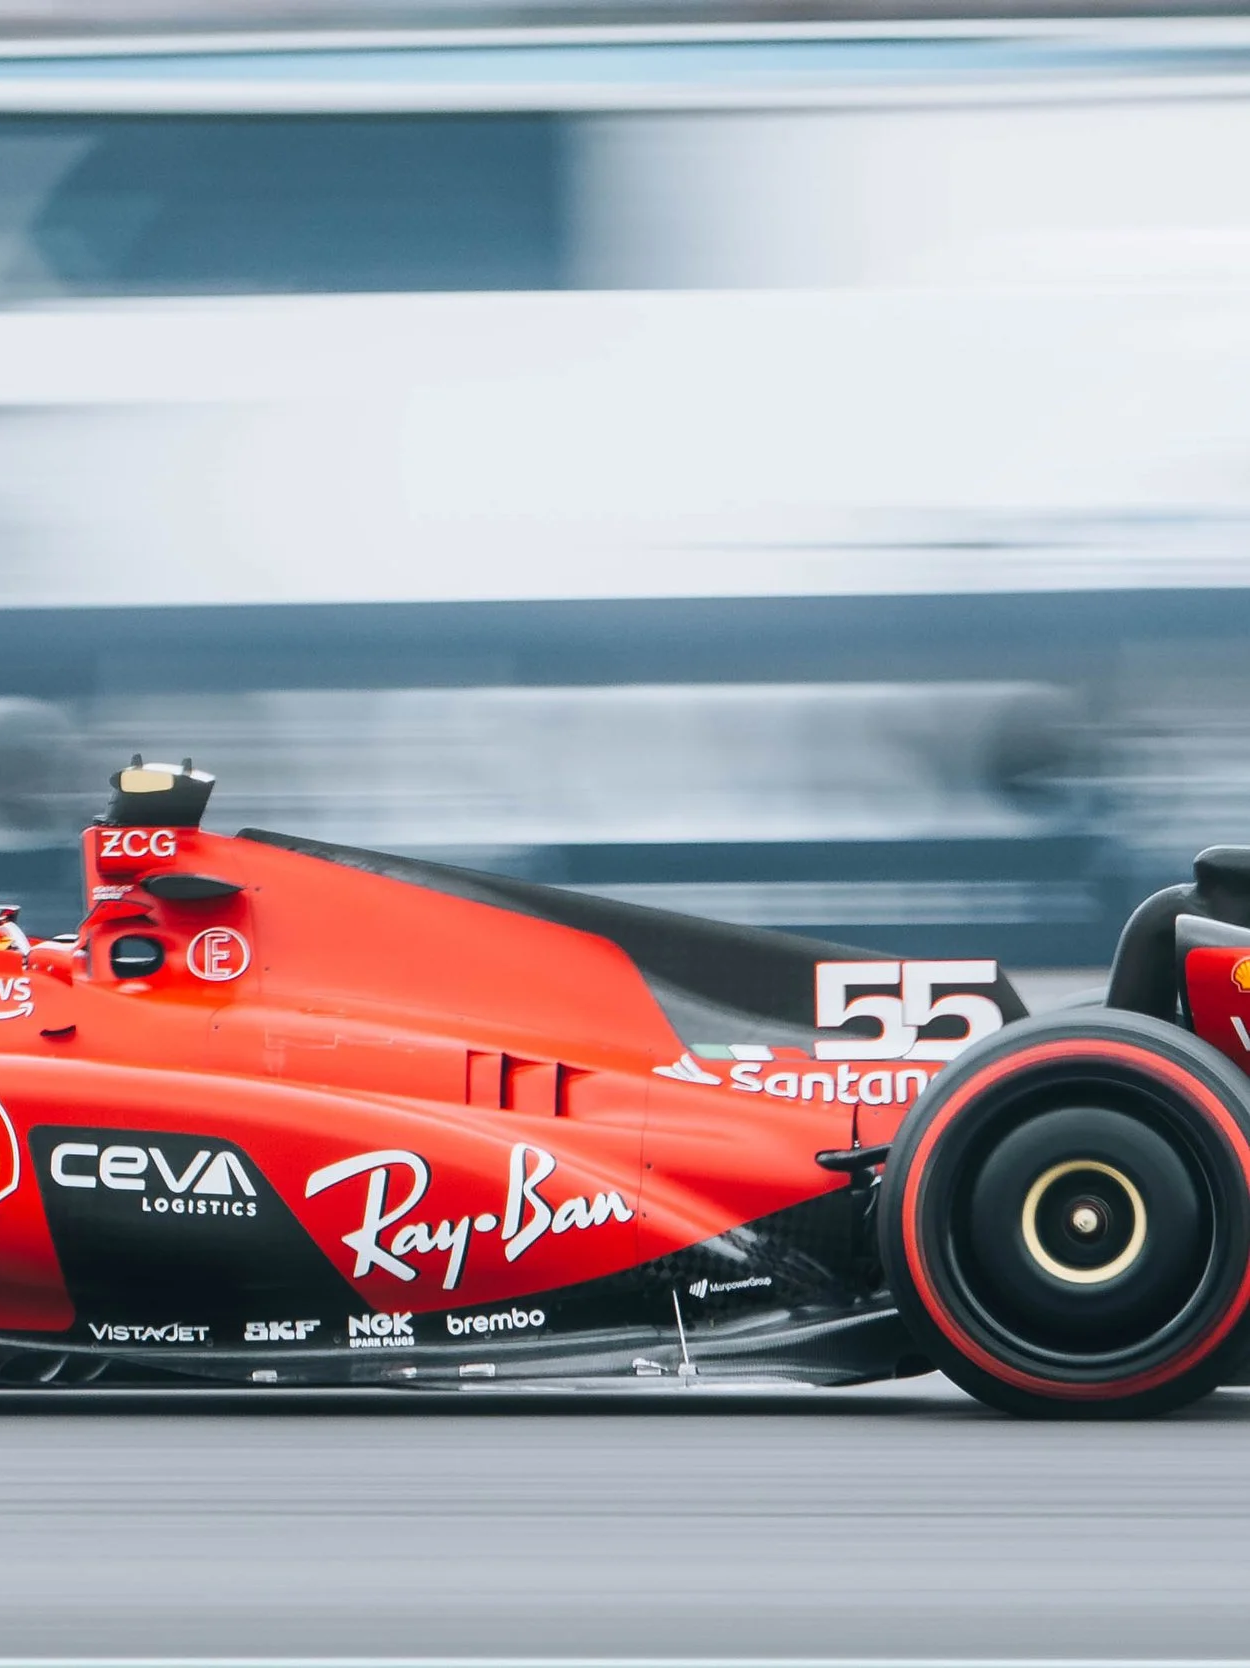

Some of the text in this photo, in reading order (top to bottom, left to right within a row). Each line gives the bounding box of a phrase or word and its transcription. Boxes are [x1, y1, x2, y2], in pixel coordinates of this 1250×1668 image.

[100, 830, 177, 858] ZCG
[814, 960, 1004, 1060] 55
[729, 1062, 939, 1106] Santan
[142, 1197, 257, 1217] LOGISTICS
[710, 1277, 772, 1292] ManpowerGroup
[244, 1319, 321, 1341] SKF
[348, 1311, 414, 1337] NGK
[446, 1308, 546, 1335] brembo
[349, 1335, 415, 1348] SPARK PLUGS
